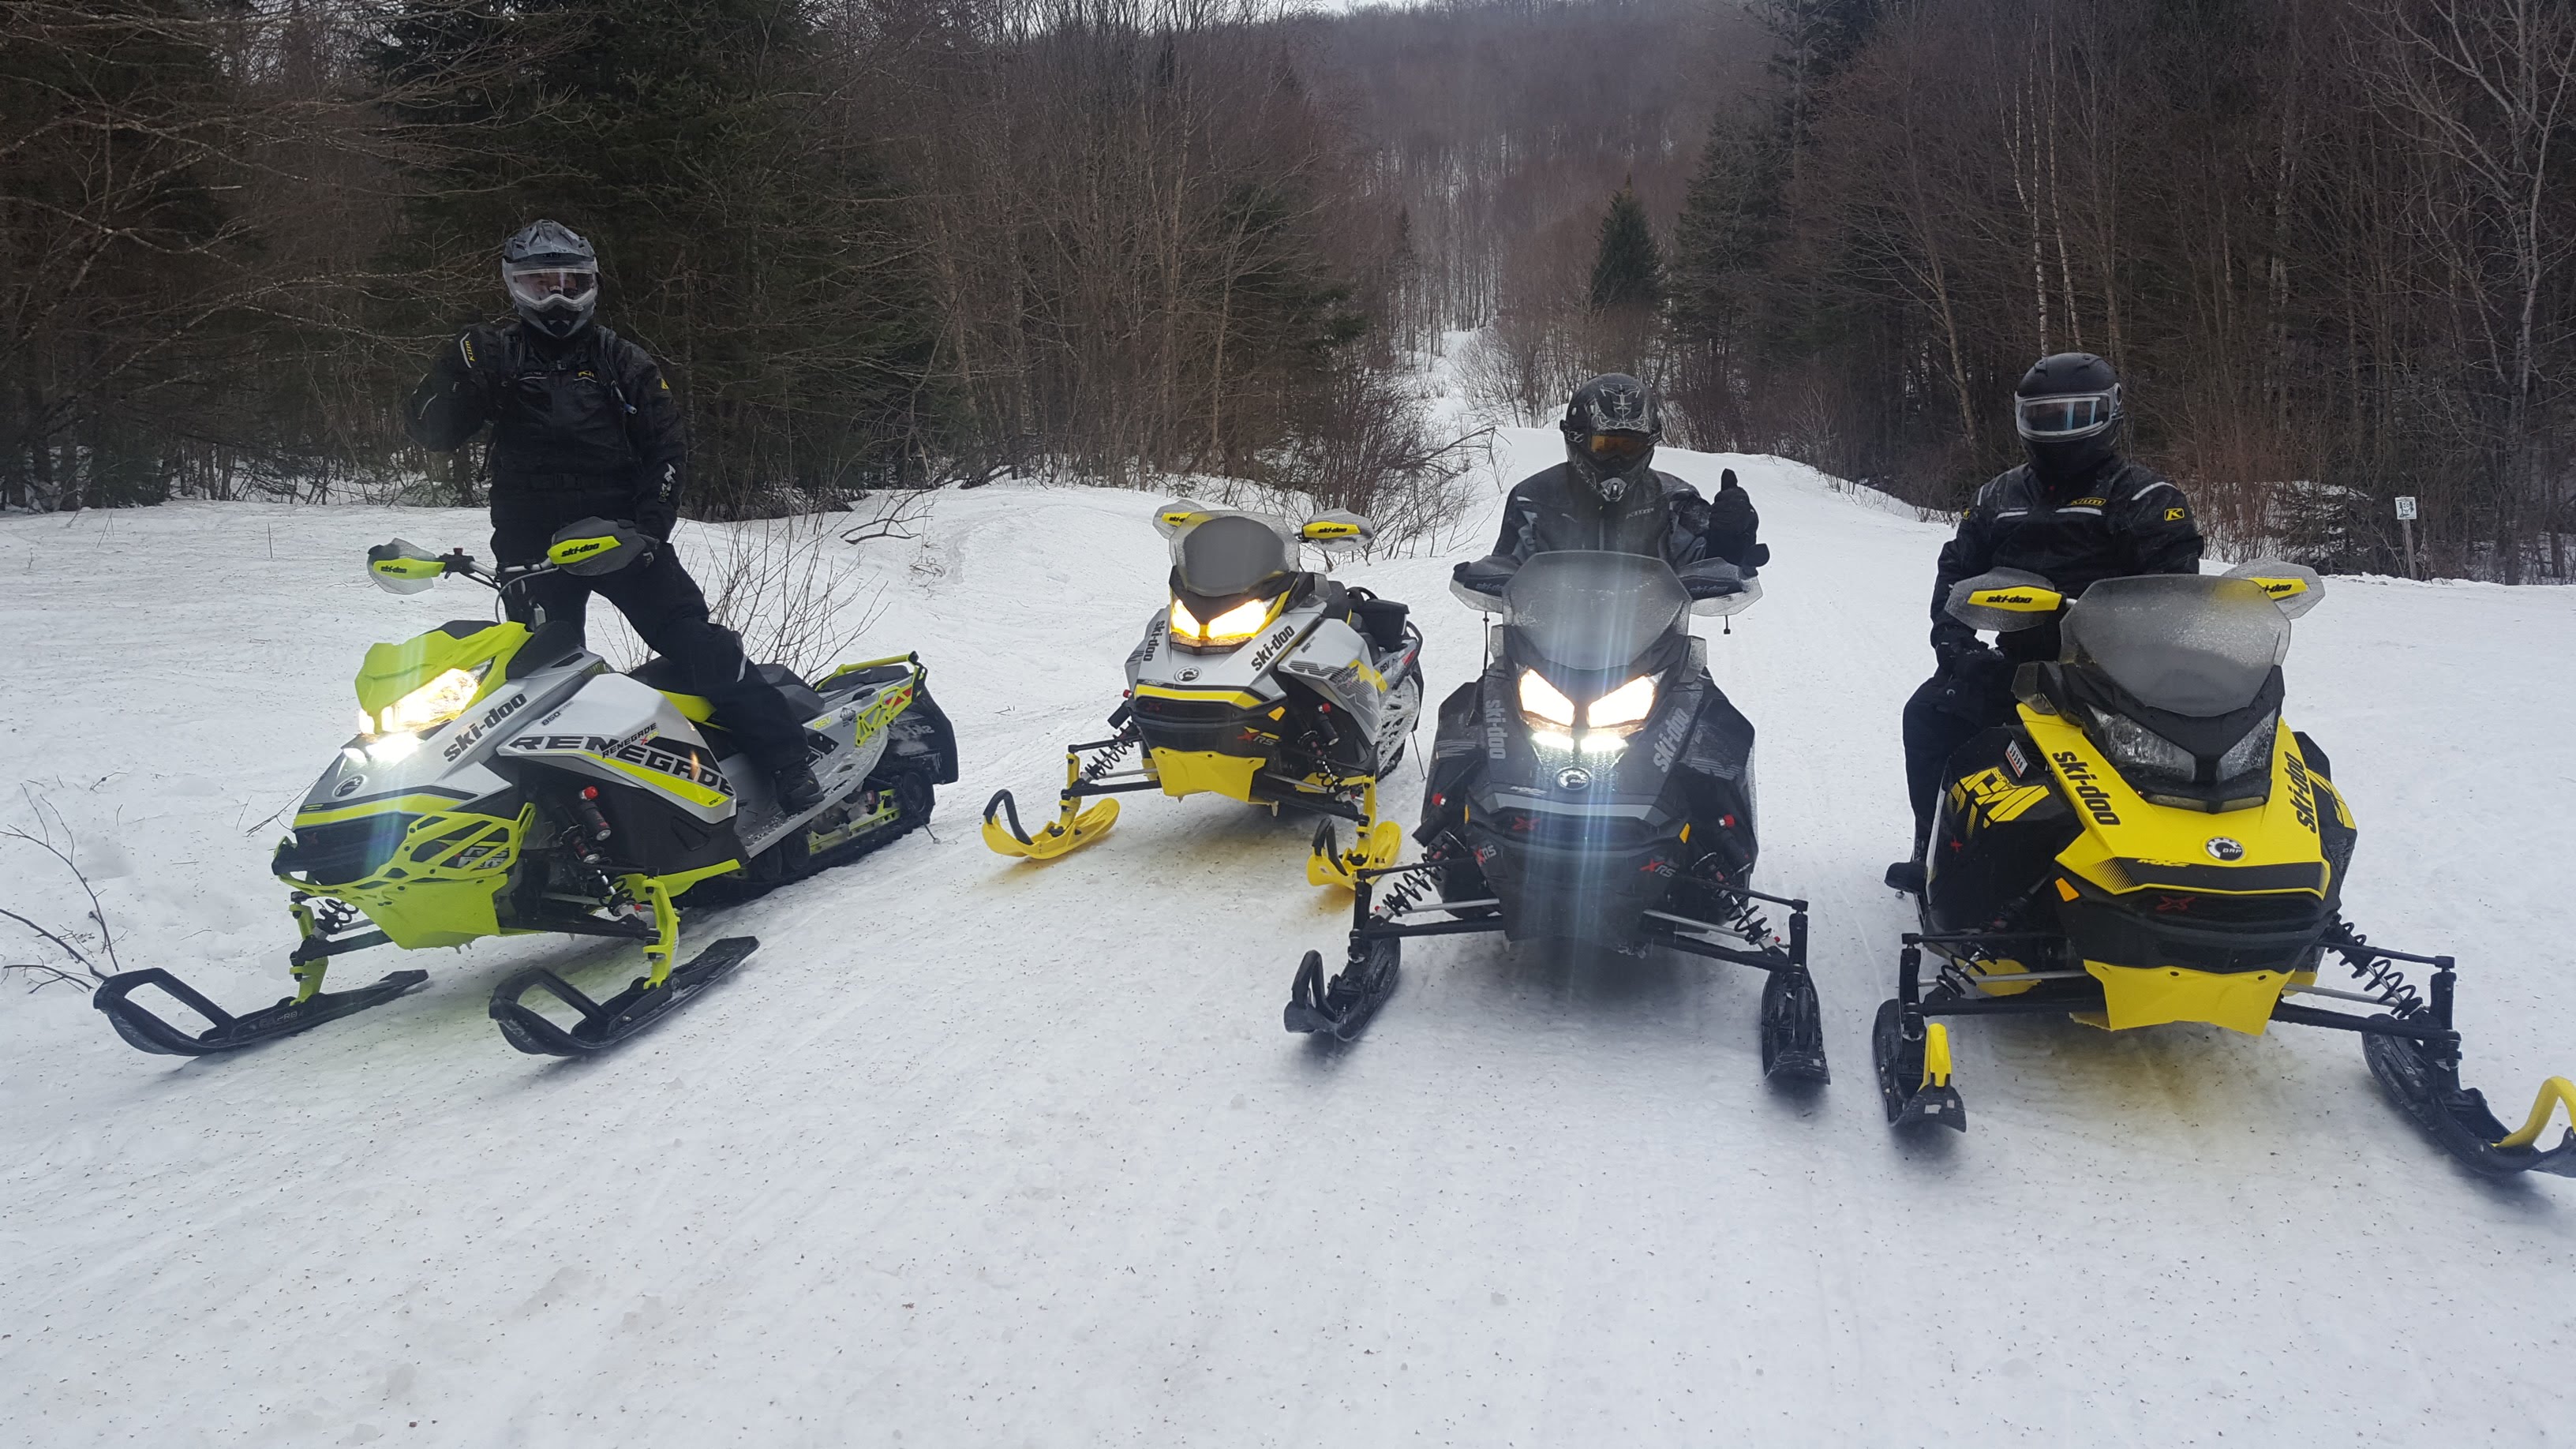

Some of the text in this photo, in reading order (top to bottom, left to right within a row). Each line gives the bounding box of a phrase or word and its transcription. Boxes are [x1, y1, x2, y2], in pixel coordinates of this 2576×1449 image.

[380, 565, 407, 574] ski-doo
[561, 542, 600, 557] ski-doo
[1986, 595, 2033, 604] ski-doo
[1143, 620, 1166, 662] ski-doo
[1251, 625, 1295, 672] ski-doo
[444, 693, 527, 762] ski-doo
[602, 722, 657, 759] RENEGADE
[813, 716, 833, 729] REV
[1485, 699, 1508, 759] ski-doo
[1653, 707, 1690, 773] ski-doo
[508, 736, 735, 796] RENEGADE
[2052, 751, 2121, 826] ski-doo
[2284, 751, 2317, 834] ski-doo
